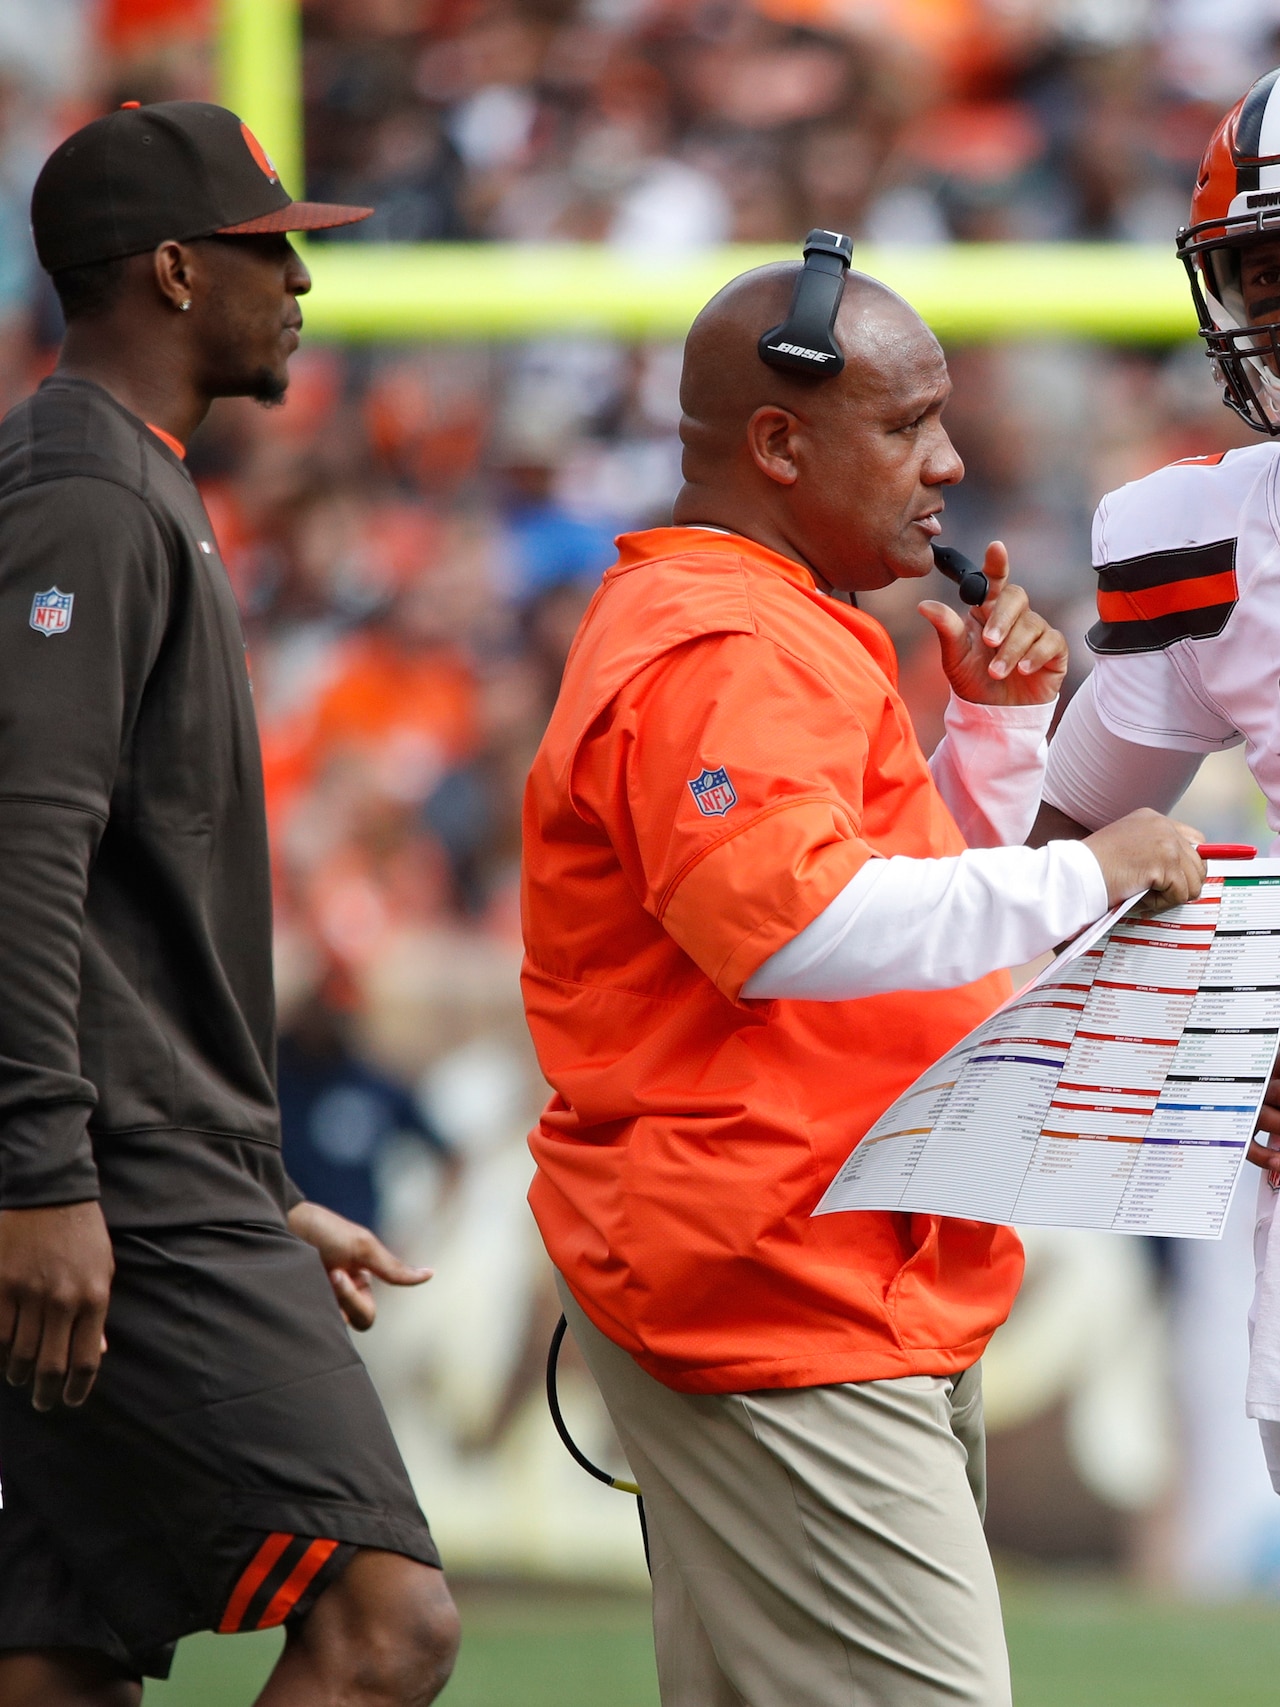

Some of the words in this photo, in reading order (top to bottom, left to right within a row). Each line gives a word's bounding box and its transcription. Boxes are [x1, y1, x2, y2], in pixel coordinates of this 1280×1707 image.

[767, 342, 837, 363] BOSE
[34, 607, 65, 629] NFL
[698, 785, 733, 812] NFL
